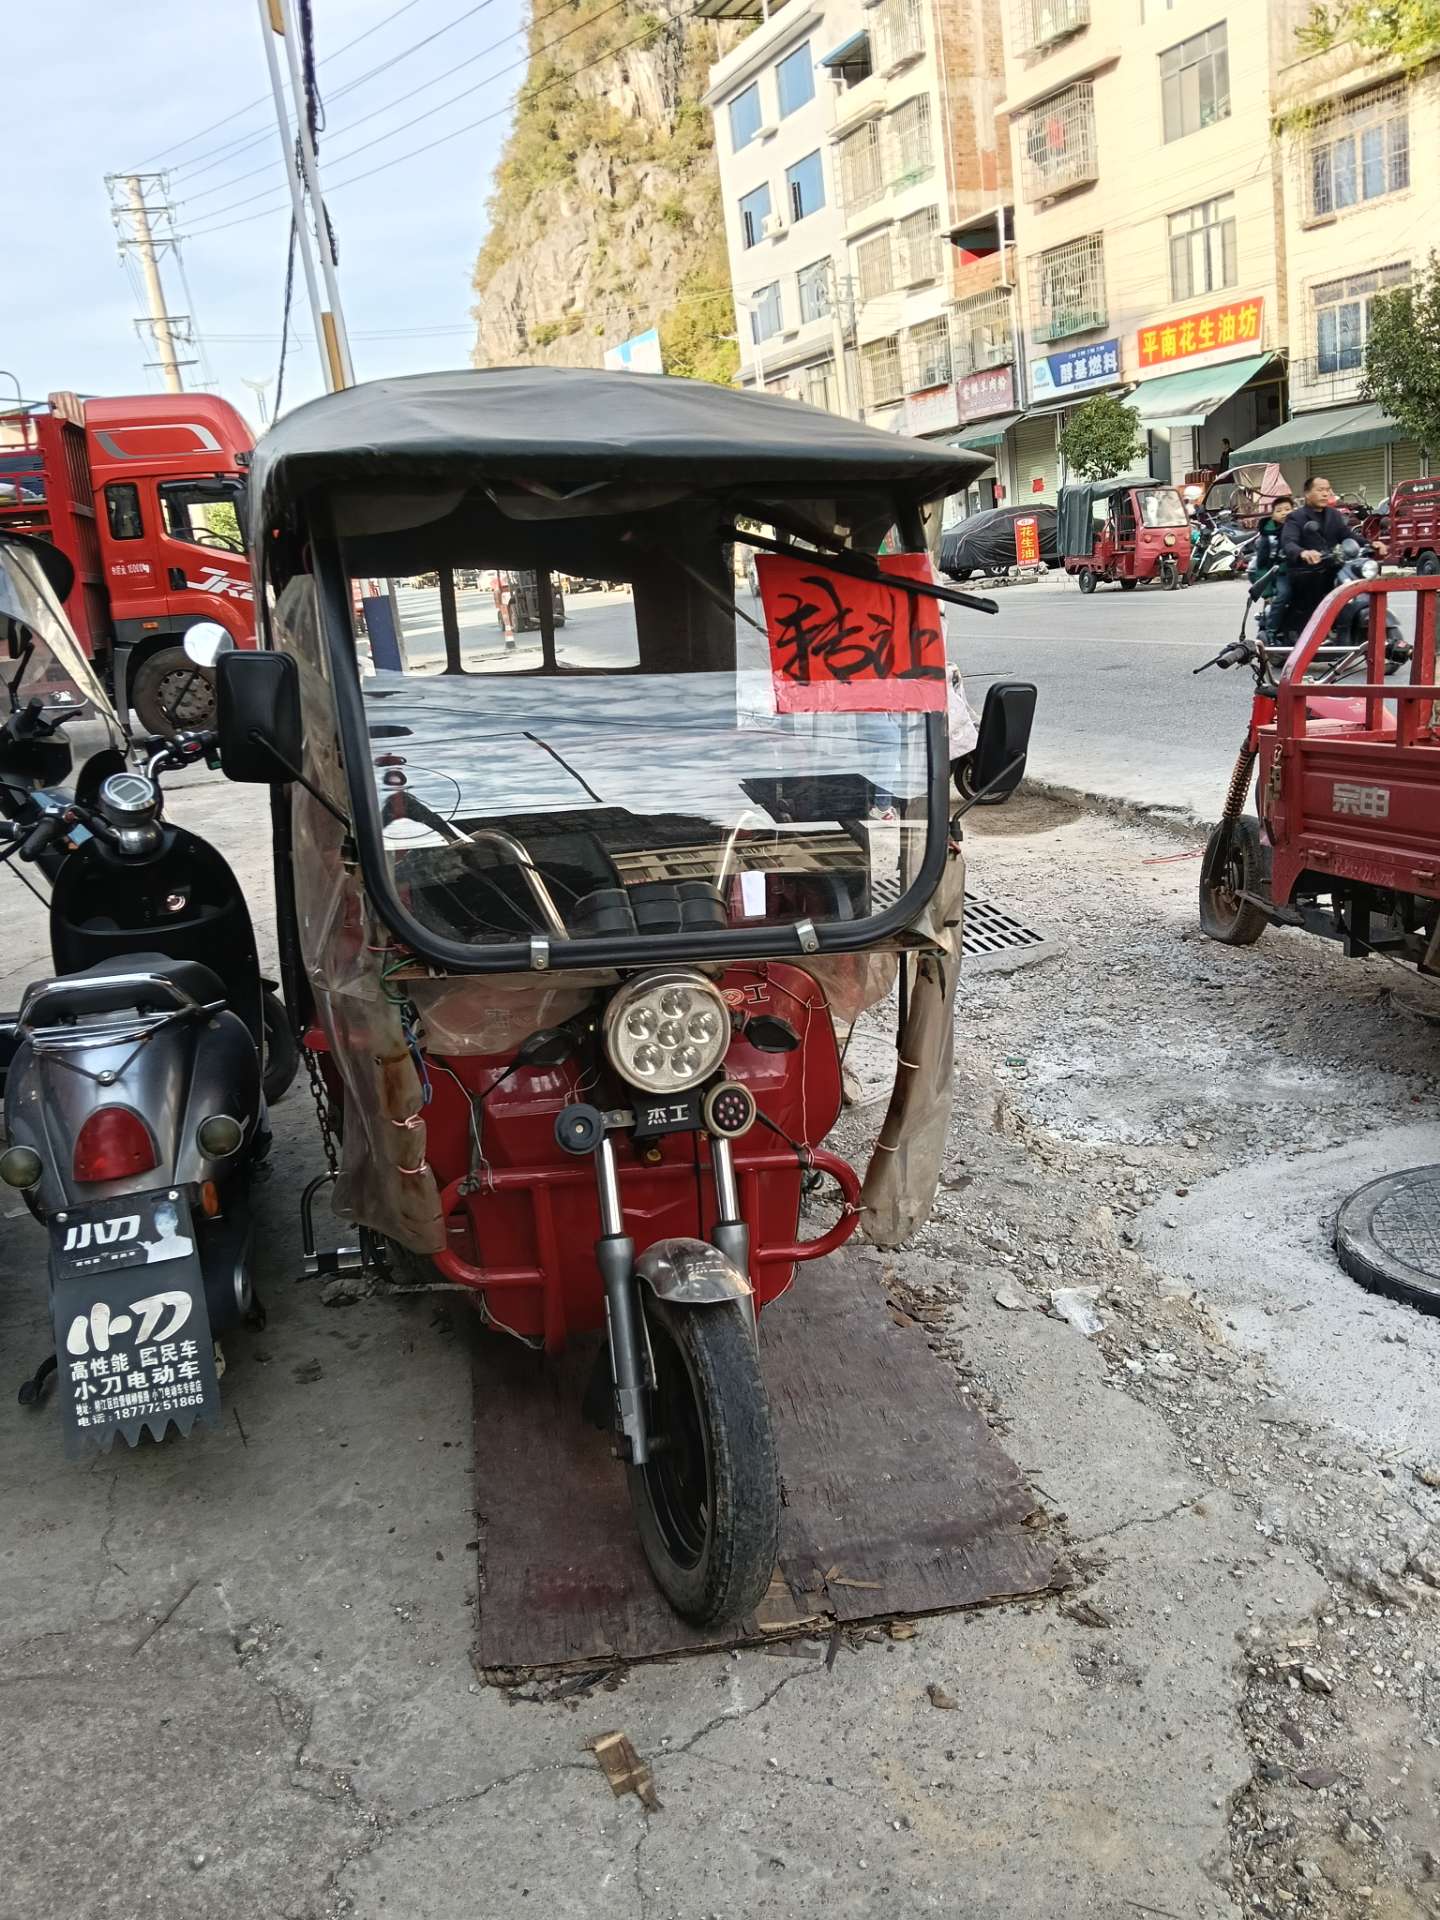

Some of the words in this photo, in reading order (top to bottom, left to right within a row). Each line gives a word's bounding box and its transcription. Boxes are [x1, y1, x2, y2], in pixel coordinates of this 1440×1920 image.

[1142, 304, 1258, 362] 平南花生油坊
[1059, 349, 1118, 384] 醇基燃料
[1020, 526, 1035, 560] 花生油
[647, 1103, 689, 1126] 杰工
[66, 1290, 193, 1356] 小刀
[69, 1352, 130, 1381] 高性能
[74, 1360, 201, 1401] 小刀电动车
